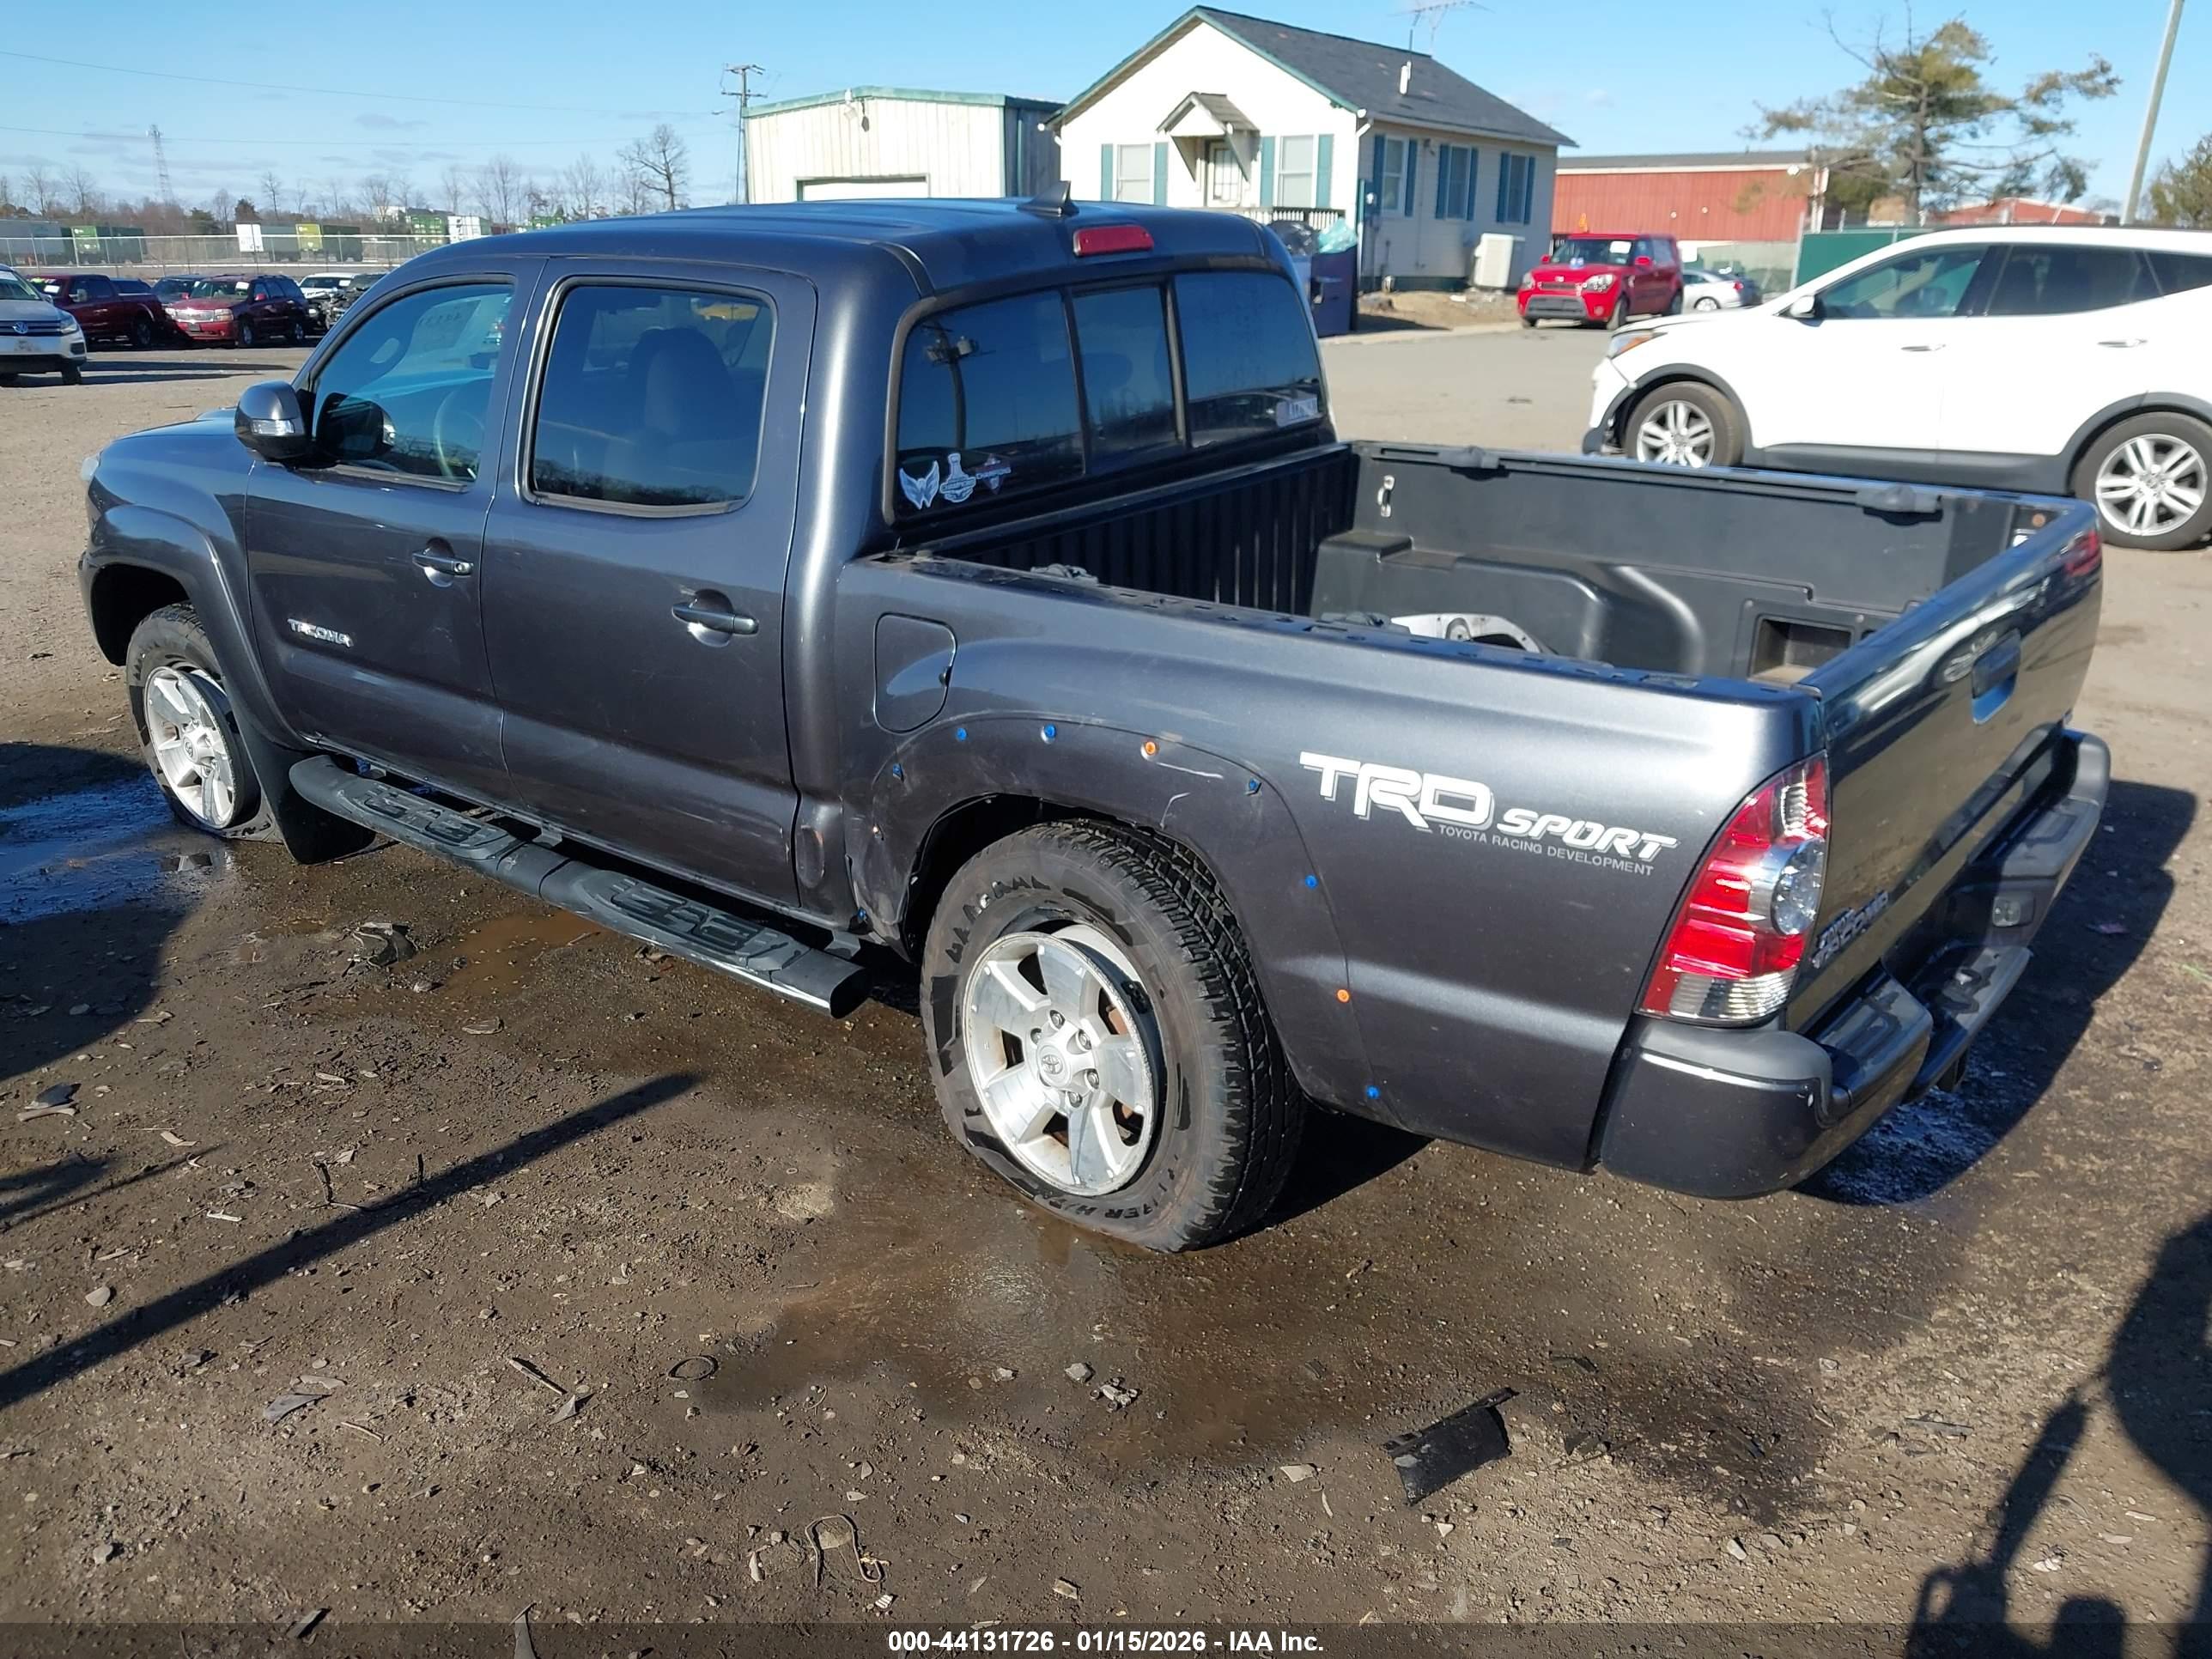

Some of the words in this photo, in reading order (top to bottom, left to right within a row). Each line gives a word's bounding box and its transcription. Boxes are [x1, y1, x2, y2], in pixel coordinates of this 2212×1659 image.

[1299, 751, 1494, 833] TRD
[1497, 807, 1682, 863] SPORT
[1438, 824, 1487, 844] TOYOTA
[1492, 835, 1543, 854] RACING
[1547, 846, 1654, 876] DEVELOPMENT
